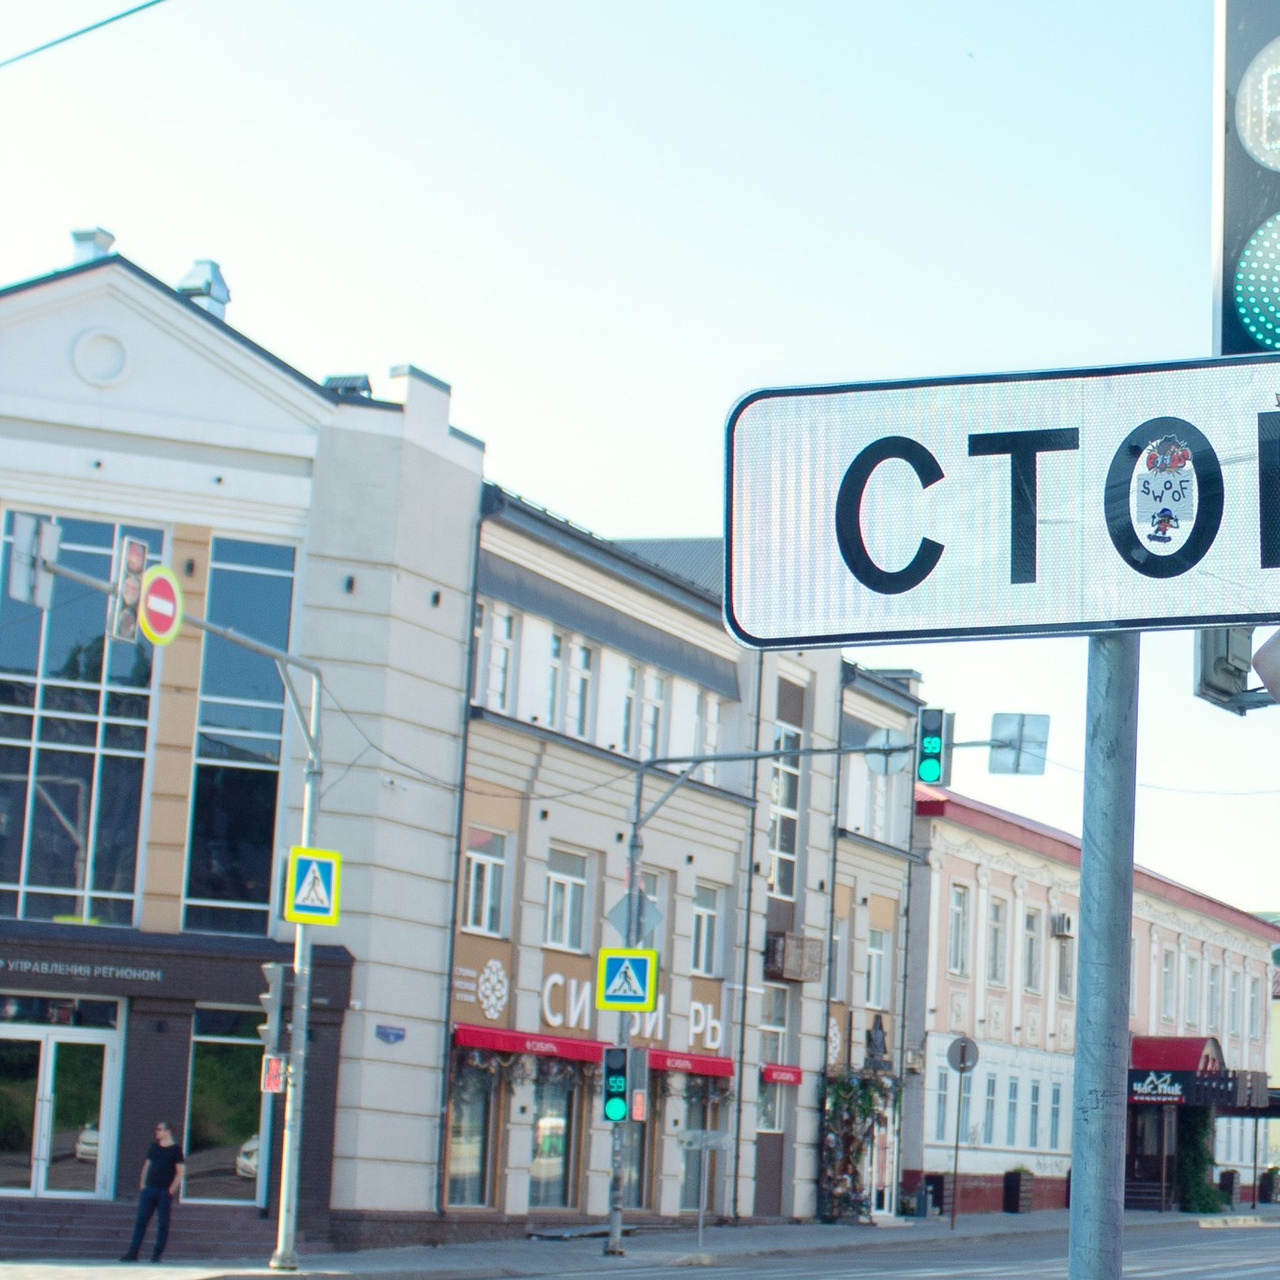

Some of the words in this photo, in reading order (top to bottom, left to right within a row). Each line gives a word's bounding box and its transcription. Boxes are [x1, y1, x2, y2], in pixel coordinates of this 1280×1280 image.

[923, 736, 941, 754] 59
[8, 959, 90, 977] УПРАВЛЕНИЯ
[93, 965, 162, 982] РЕГИОНОМ
[542, 972, 723, 1050] СИИРЬ
[609, 1075, 626, 1092] 59
